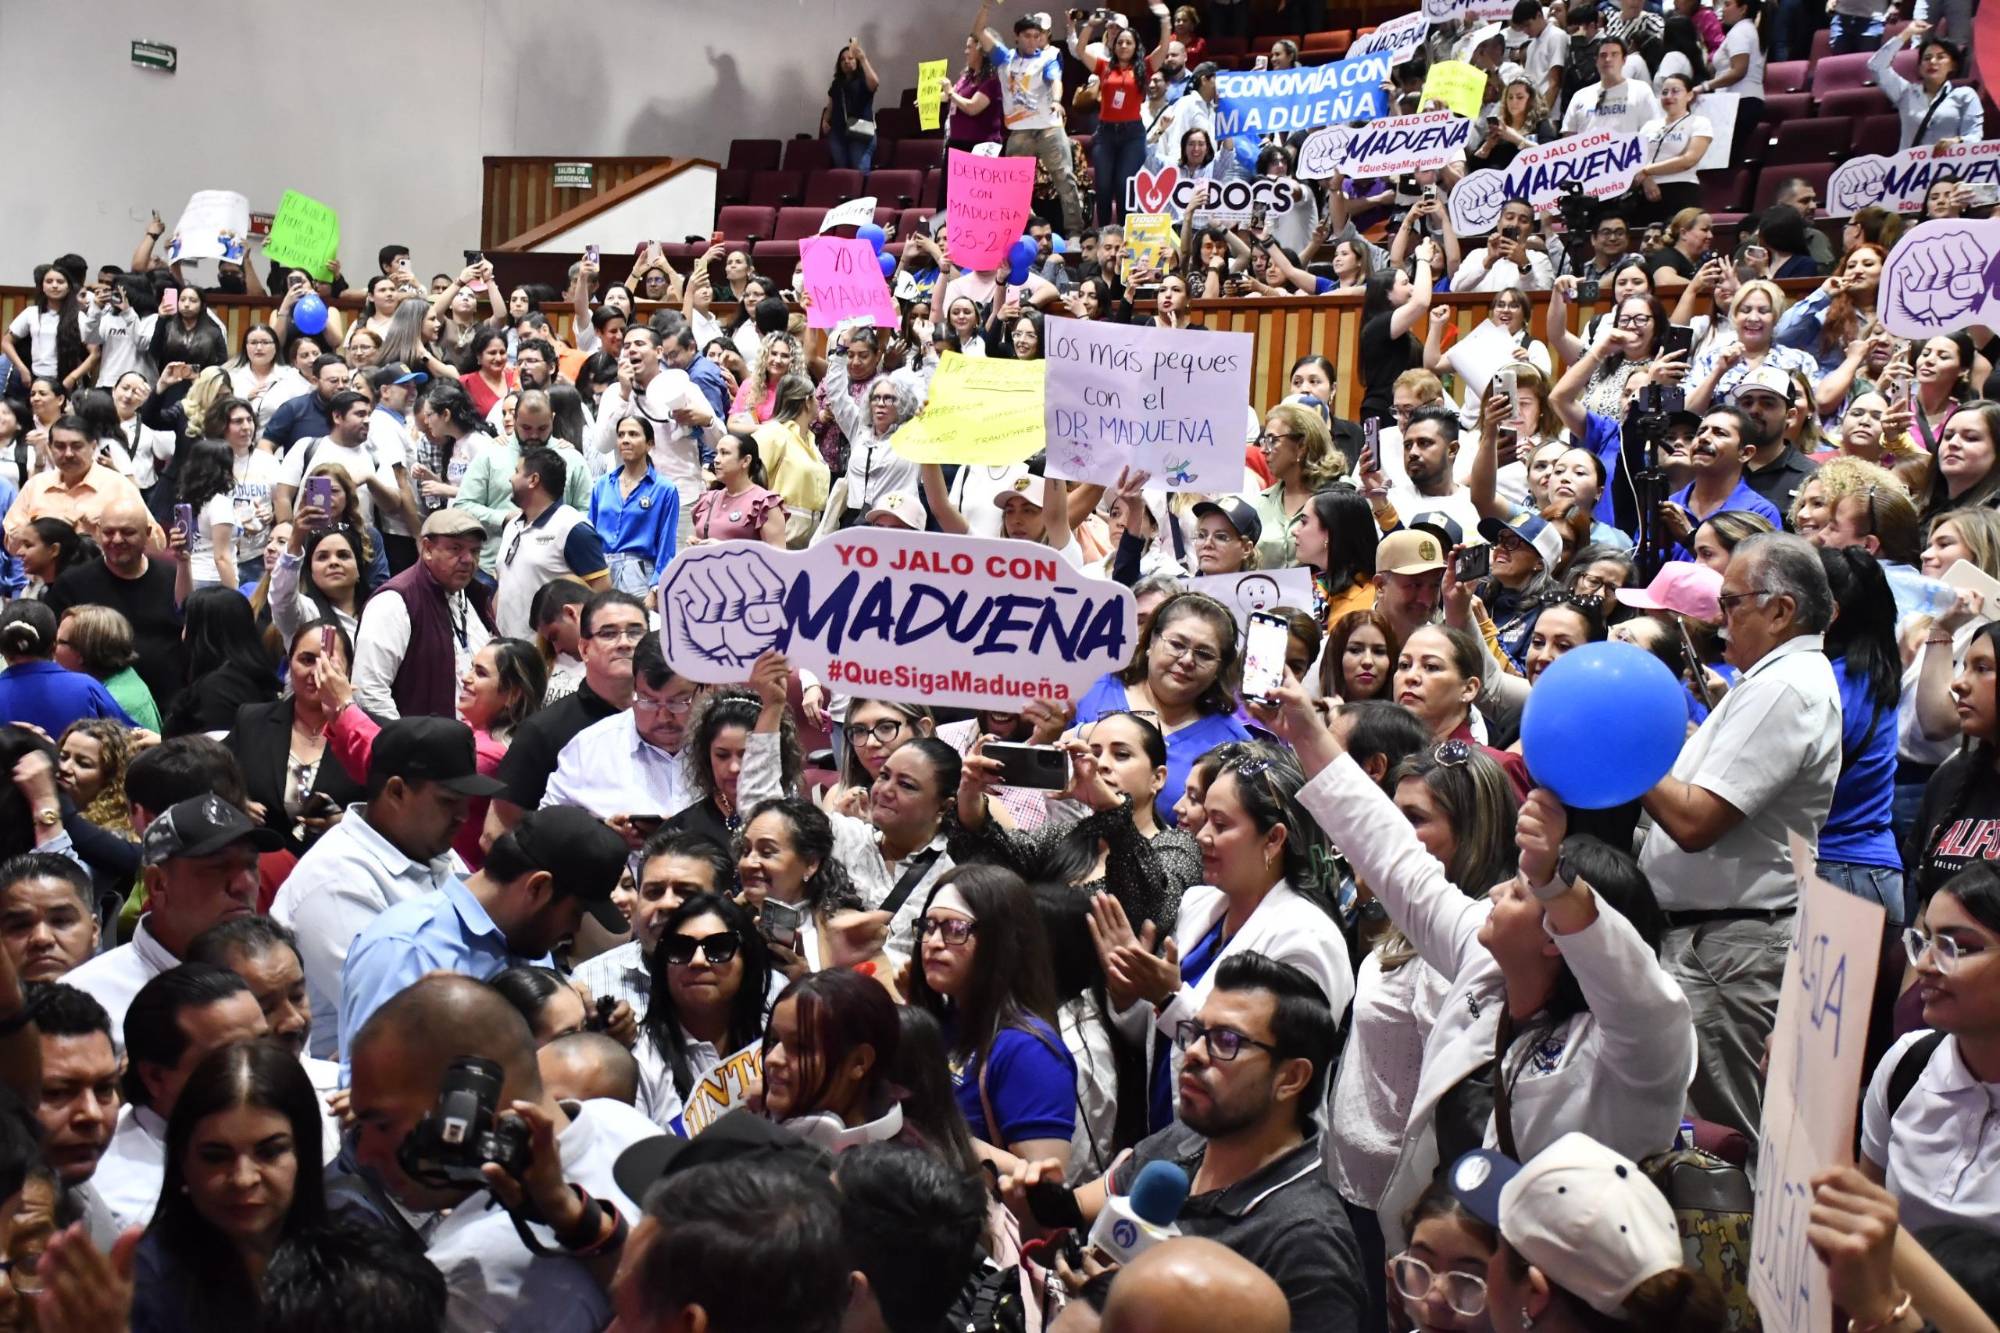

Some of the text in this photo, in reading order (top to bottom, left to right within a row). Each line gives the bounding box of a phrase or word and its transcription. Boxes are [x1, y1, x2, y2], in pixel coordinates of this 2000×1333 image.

[1215, 56, 1391, 99] ECONOMÍA CON
[1216, 90, 1376, 136] MADUEÑA
[1371, 112, 1450, 129] YO JALO CON
[1340, 120, 1470, 164] MADUEÑA
[1520, 133, 1610, 166] YO JALO CON
[1908, 150, 1927, 161] YO
[953, 161, 1031, 184] DEPORTES
[1357, 156, 1444, 174] #QueSigaMadueña
[1503, 136, 1642, 202] MADUEÑA
[950, 199, 1022, 220] MADUEÑA
[969, 188, 993, 199] CON
[1172, 181, 1292, 214] CDOCS
[952, 226, 1012, 253] 25-29
[827, 245, 852, 275] YO
[1090, 343, 1143, 373] más
[1154, 351, 1239, 384] peques
[1084, 386, 1165, 410] con el
[1100, 415, 1214, 447] MADUEÑA
[834, 544, 1057, 582] YO JALO CON
[775, 569, 1127, 662] MADUEÑA
[827, 659, 1070, 700] #QueSigaMadueña
